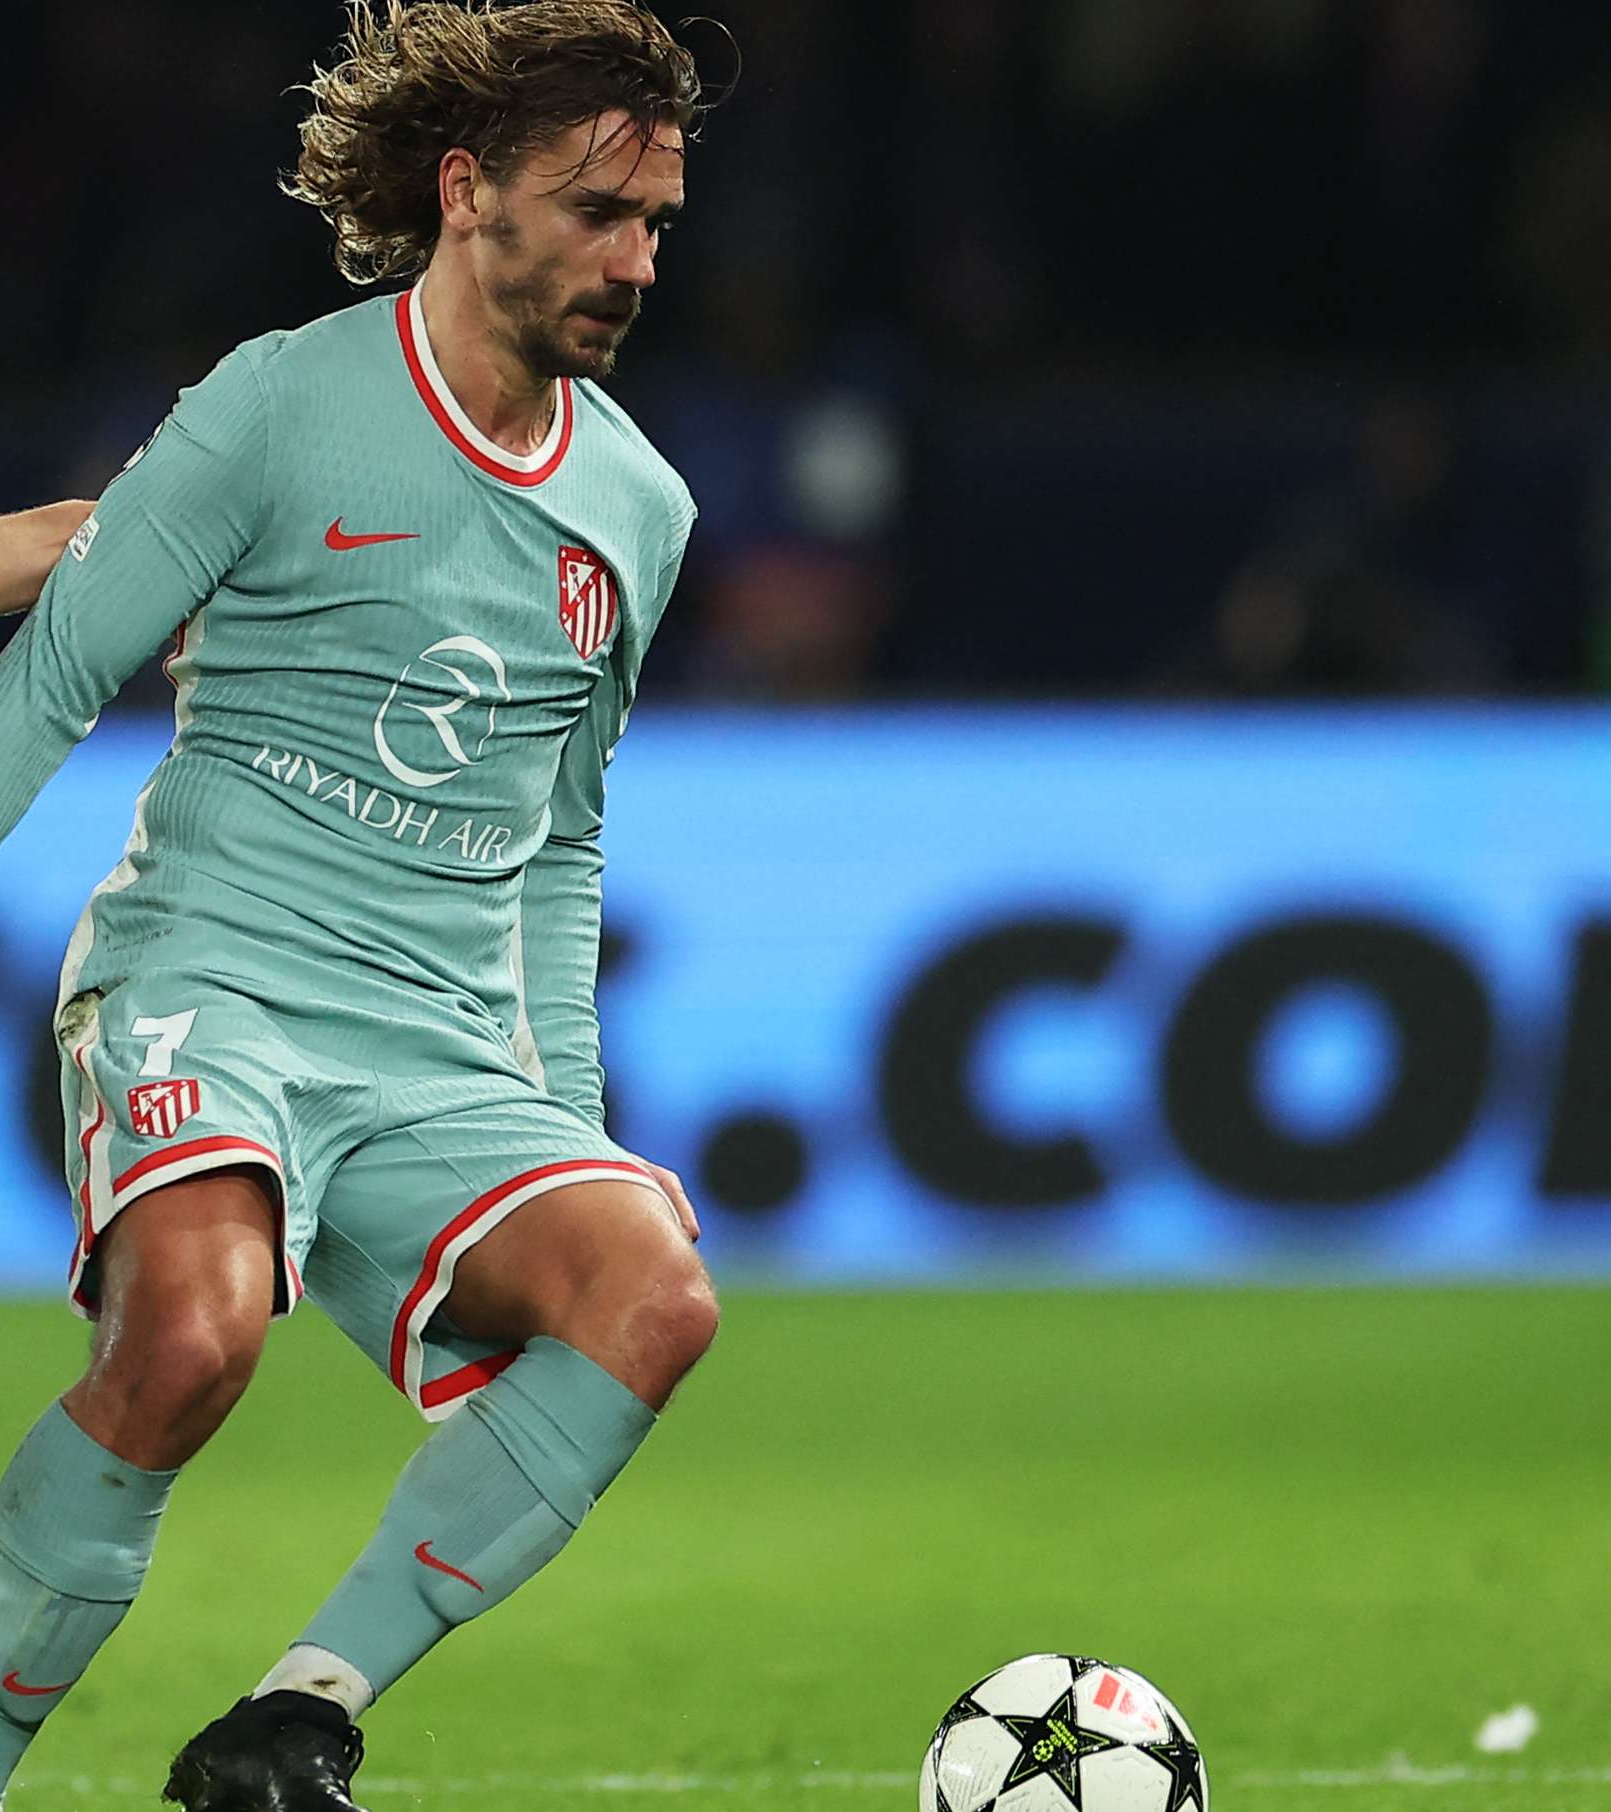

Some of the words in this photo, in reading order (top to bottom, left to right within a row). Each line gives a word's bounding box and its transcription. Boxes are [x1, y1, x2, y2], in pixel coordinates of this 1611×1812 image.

[252, 744, 438, 847] RIYADH
[437, 818, 512, 865] AIR
[130, 1007, 199, 1077] 7
